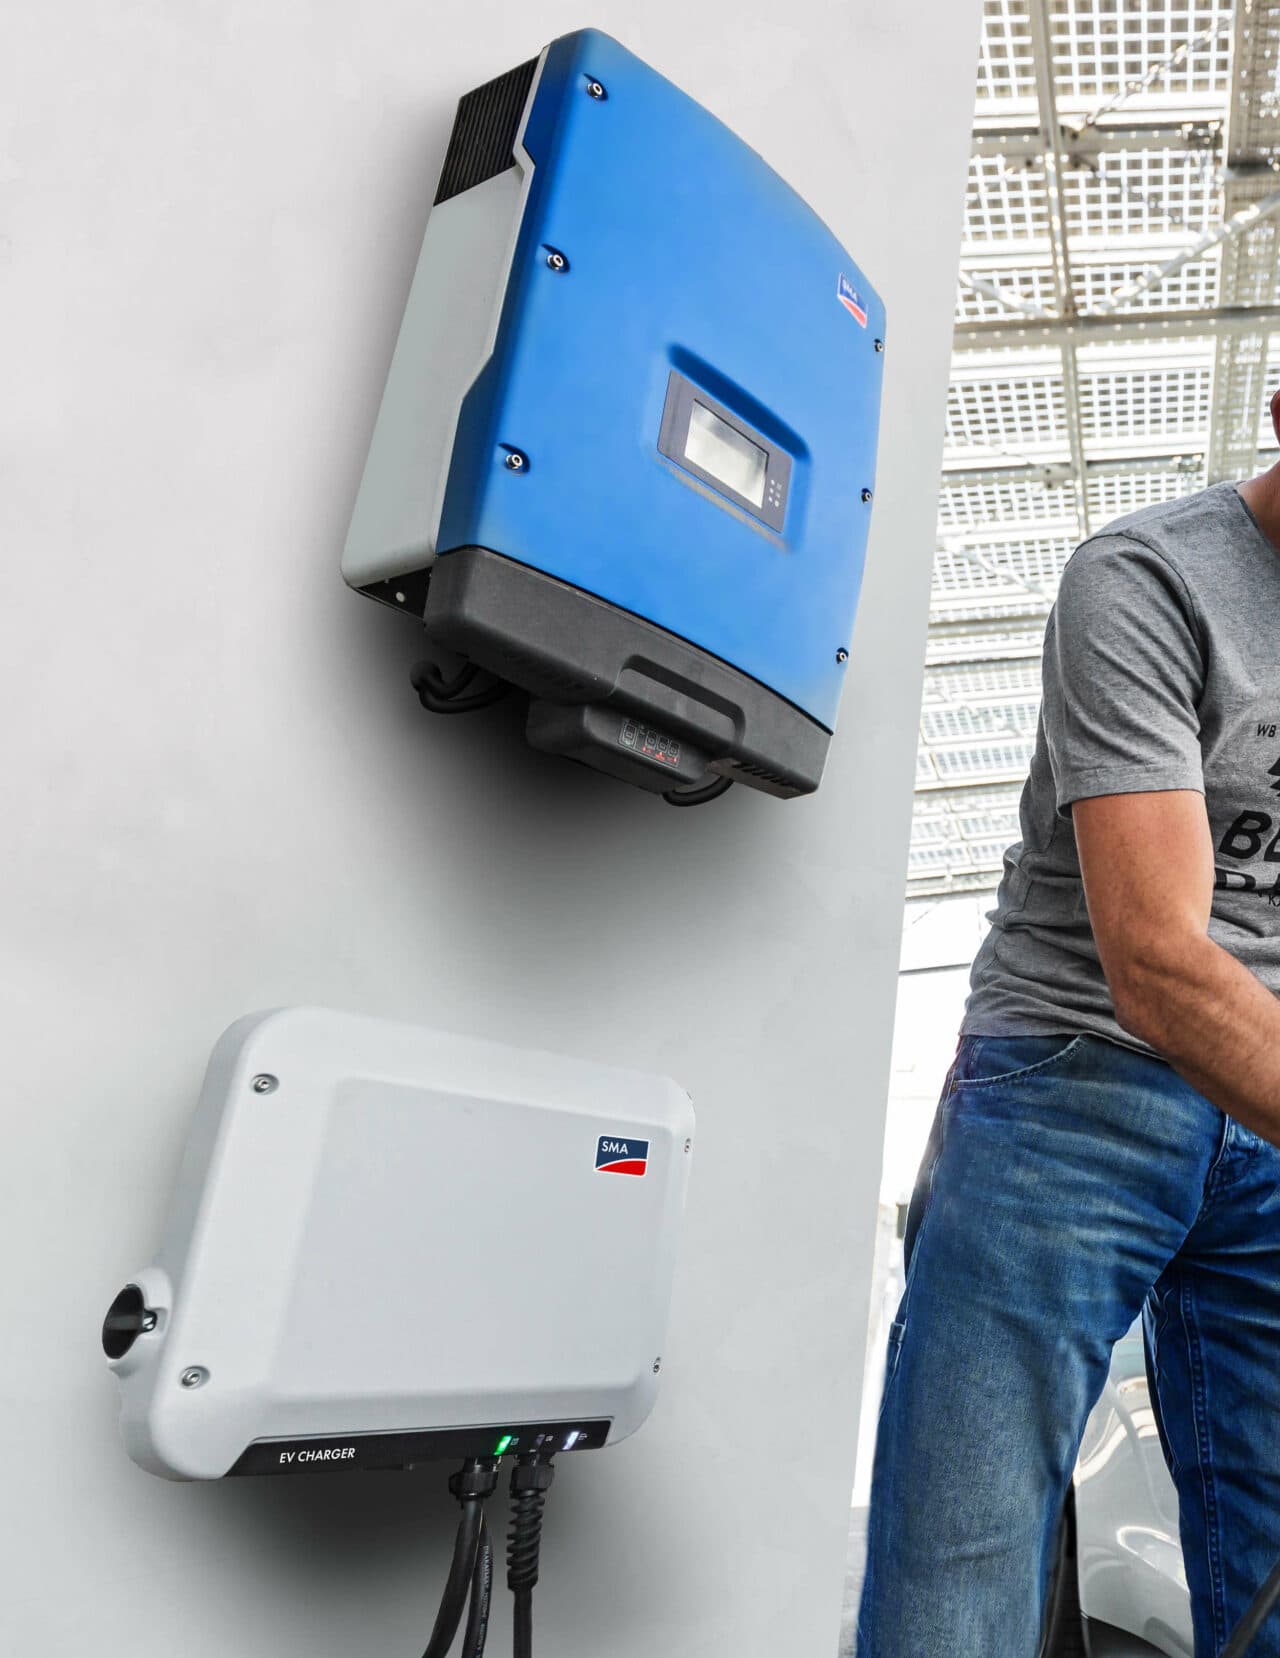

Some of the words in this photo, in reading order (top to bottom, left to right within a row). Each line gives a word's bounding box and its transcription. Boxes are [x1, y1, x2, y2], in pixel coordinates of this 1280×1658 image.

[1256, 723, 1277, 738] WB
[601, 1140, 629, 1155] SMA
[279, 1451, 296, 1464] EV
[297, 1447, 356, 1462] CHARGER
